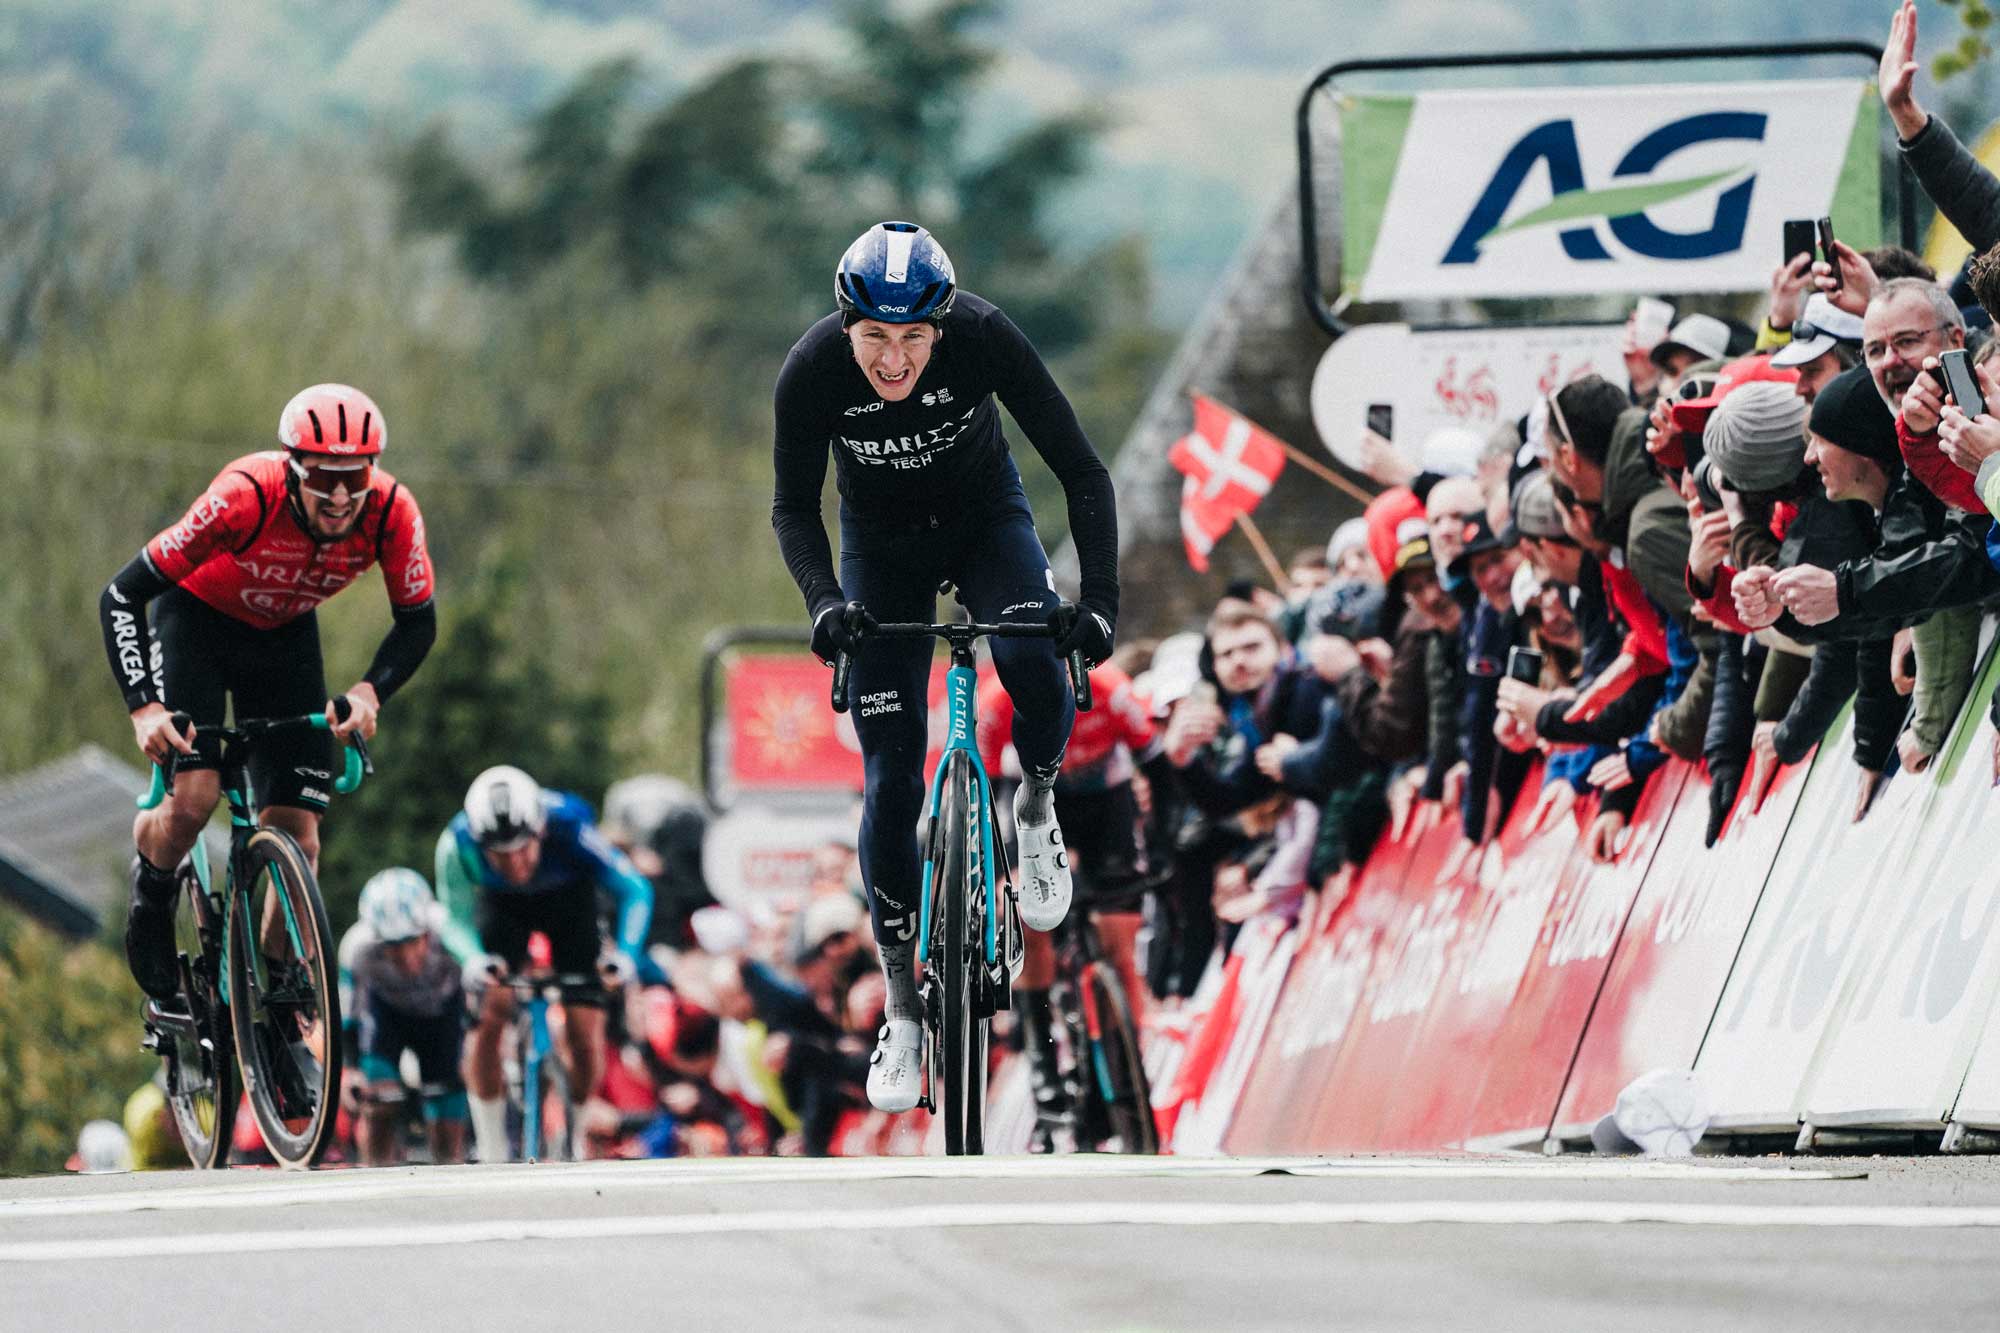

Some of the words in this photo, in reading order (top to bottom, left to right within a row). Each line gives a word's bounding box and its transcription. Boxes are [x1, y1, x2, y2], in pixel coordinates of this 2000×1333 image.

[1440, 111, 1768, 264] AG
[840, 433, 928, 455] ISRAEL
[892, 453, 933, 470] TECH
[110, 609, 147, 687] ARKEA
[860, 690, 899, 705] RACING
[954, 675, 967, 740] FACTOR
[861, 702, 903, 717] CHANGE
